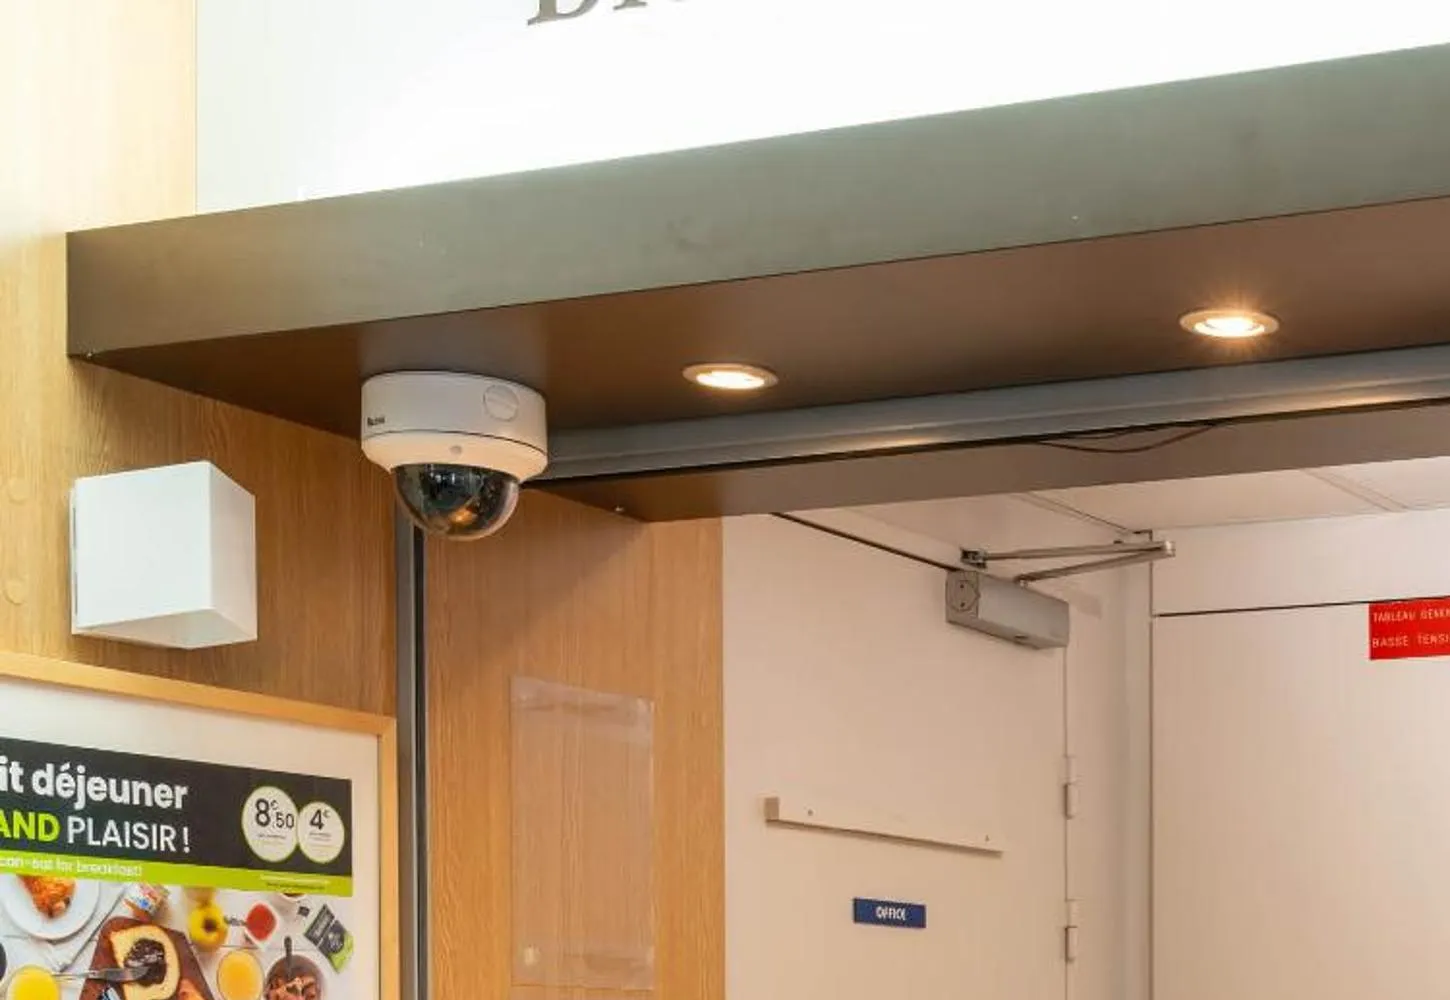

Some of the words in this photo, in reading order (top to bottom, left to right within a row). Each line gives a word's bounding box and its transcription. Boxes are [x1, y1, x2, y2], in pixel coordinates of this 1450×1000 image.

[1373, 609, 1416, 622] TABLEAU
[1372, 635, 1409, 648] BASSE
[31, 762, 188, 810] déjeuner
[67, 815, 177, 852] PLAISIR
